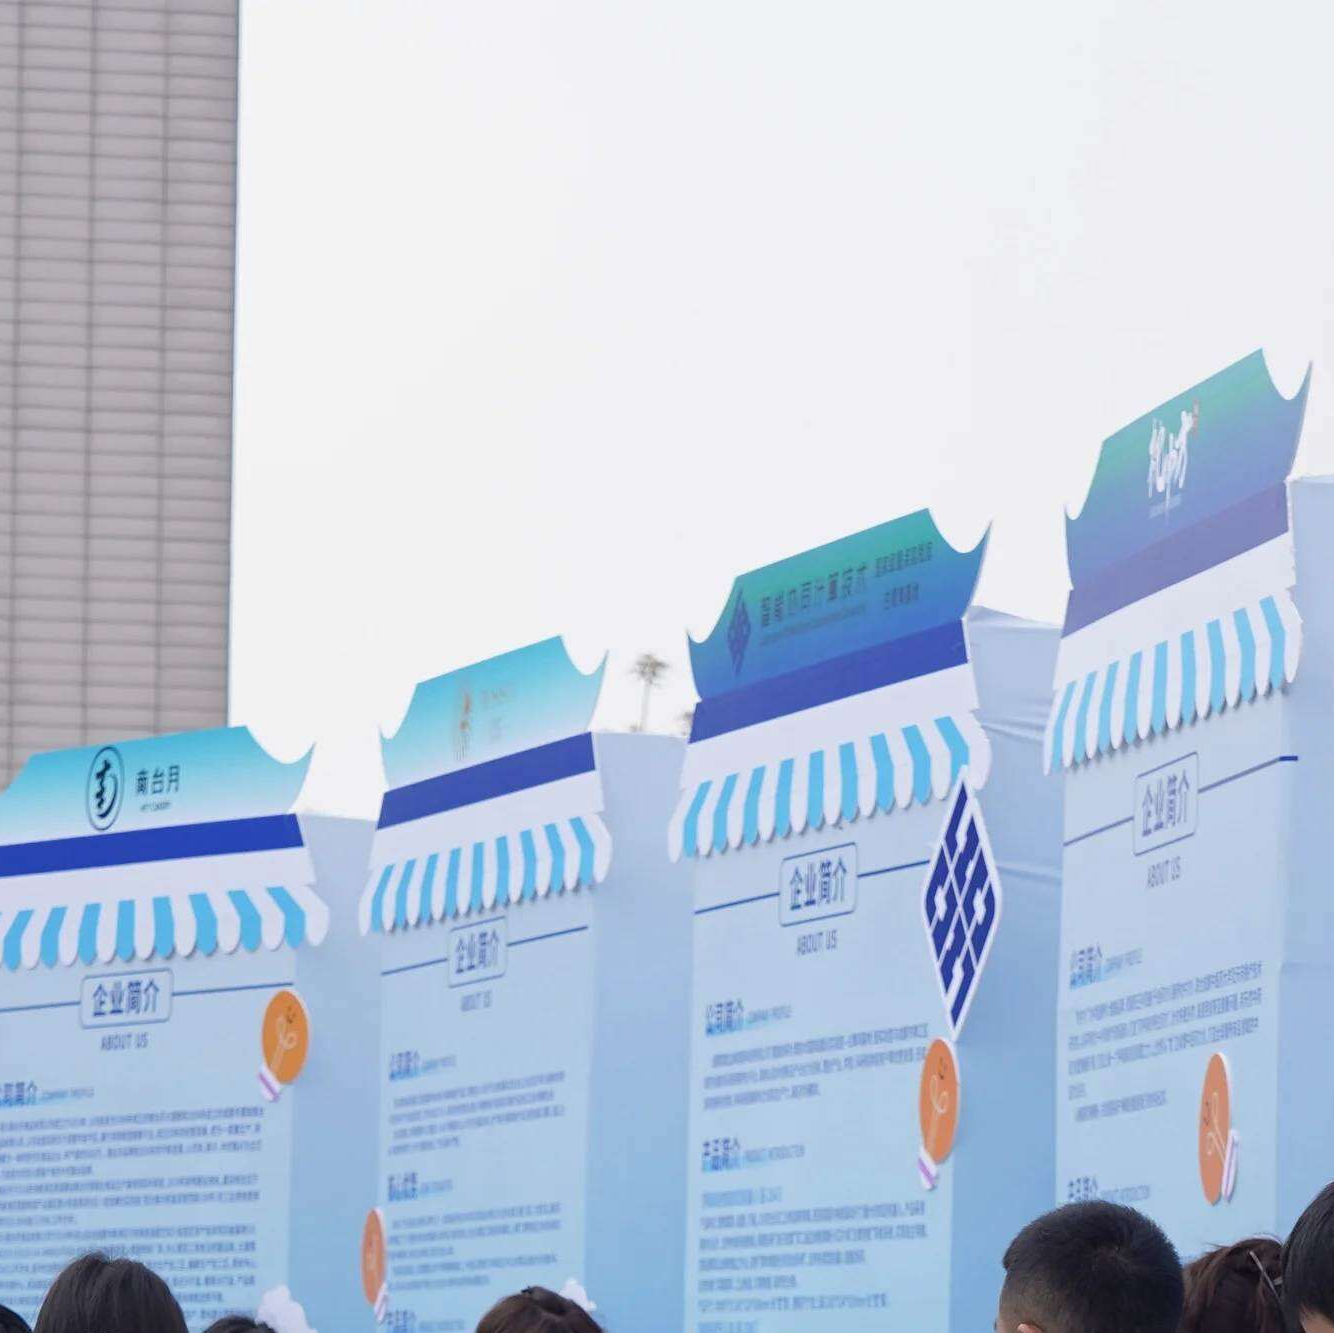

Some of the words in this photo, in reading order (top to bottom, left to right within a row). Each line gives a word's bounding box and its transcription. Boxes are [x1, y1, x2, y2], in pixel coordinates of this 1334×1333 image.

[789, 857, 848, 911] 企业简介
[796, 933, 823, 957] ABOUT
[825, 928, 838, 950] US
[93, 979, 160, 1016] 企业简介
[100, 1034, 134, 1052] ABOUT
[138, 1032, 148, 1048] US
